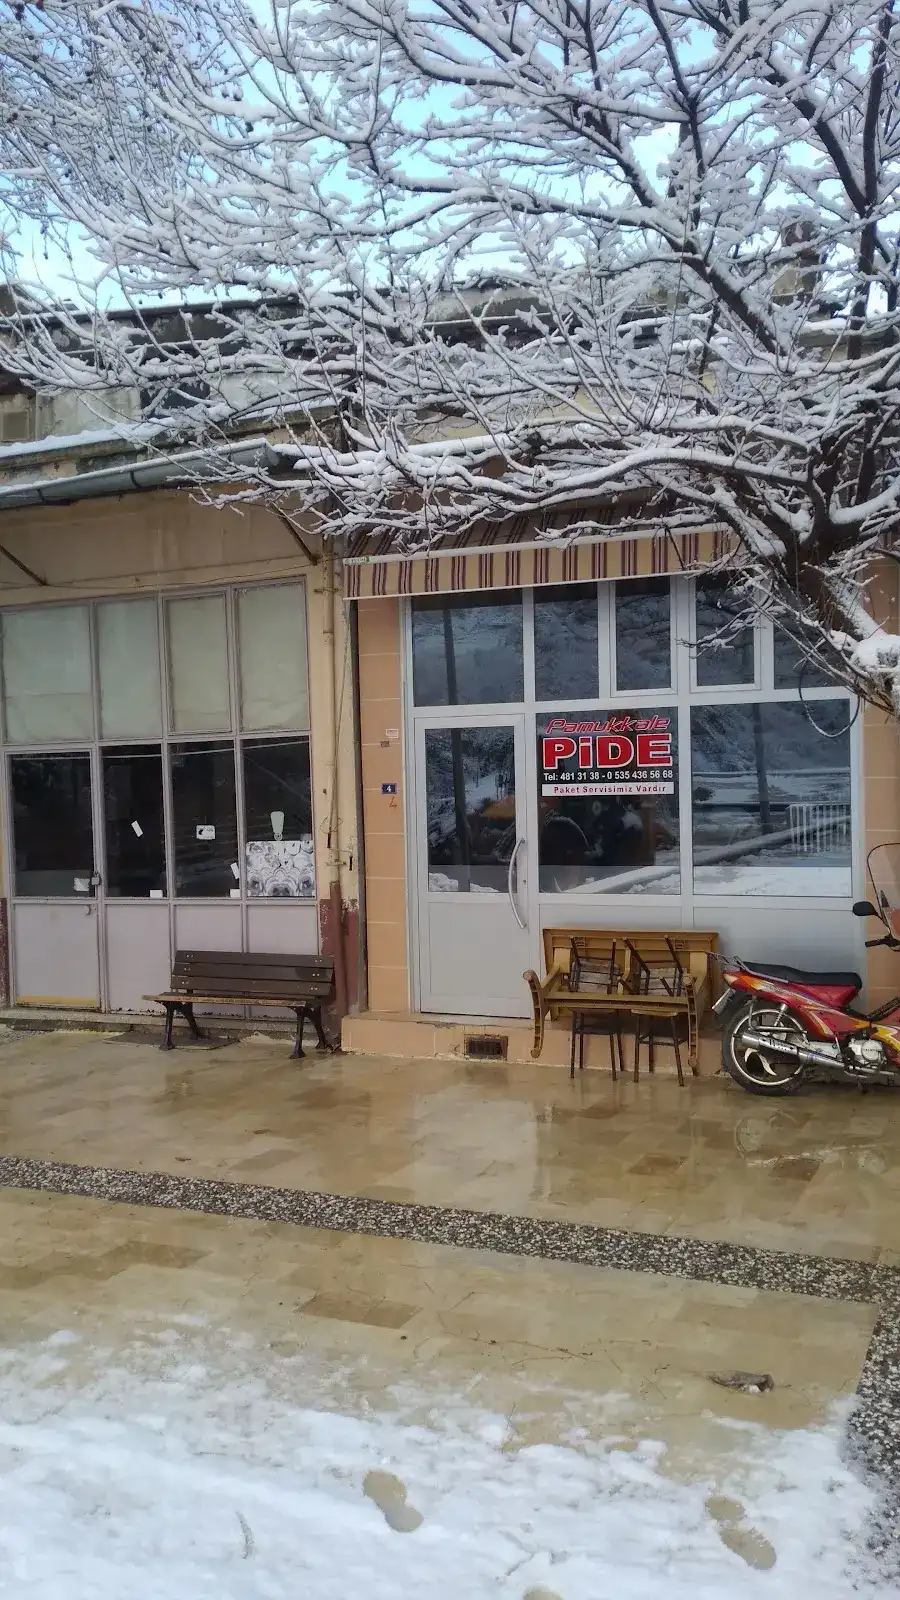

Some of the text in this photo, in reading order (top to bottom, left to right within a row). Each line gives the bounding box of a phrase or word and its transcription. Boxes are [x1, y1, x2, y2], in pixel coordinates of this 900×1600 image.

[545, 715, 671, 734] Pamukkale
[543, 772, 559, 781] Tel:
[560, 772, 575, 781] 481
[577, 771, 587, 780] 31
[589, 771, 600, 780] 38
[606, 771, 613, 780] 0
[614, 771, 630, 780] 535
[631, 770, 648, 779] 436
[650, 770, 660, 779] 56
[662, 770, 673, 779] 68
[553, 786, 580, 794] Paket
[582, 785, 633, 794] Servisimiz
